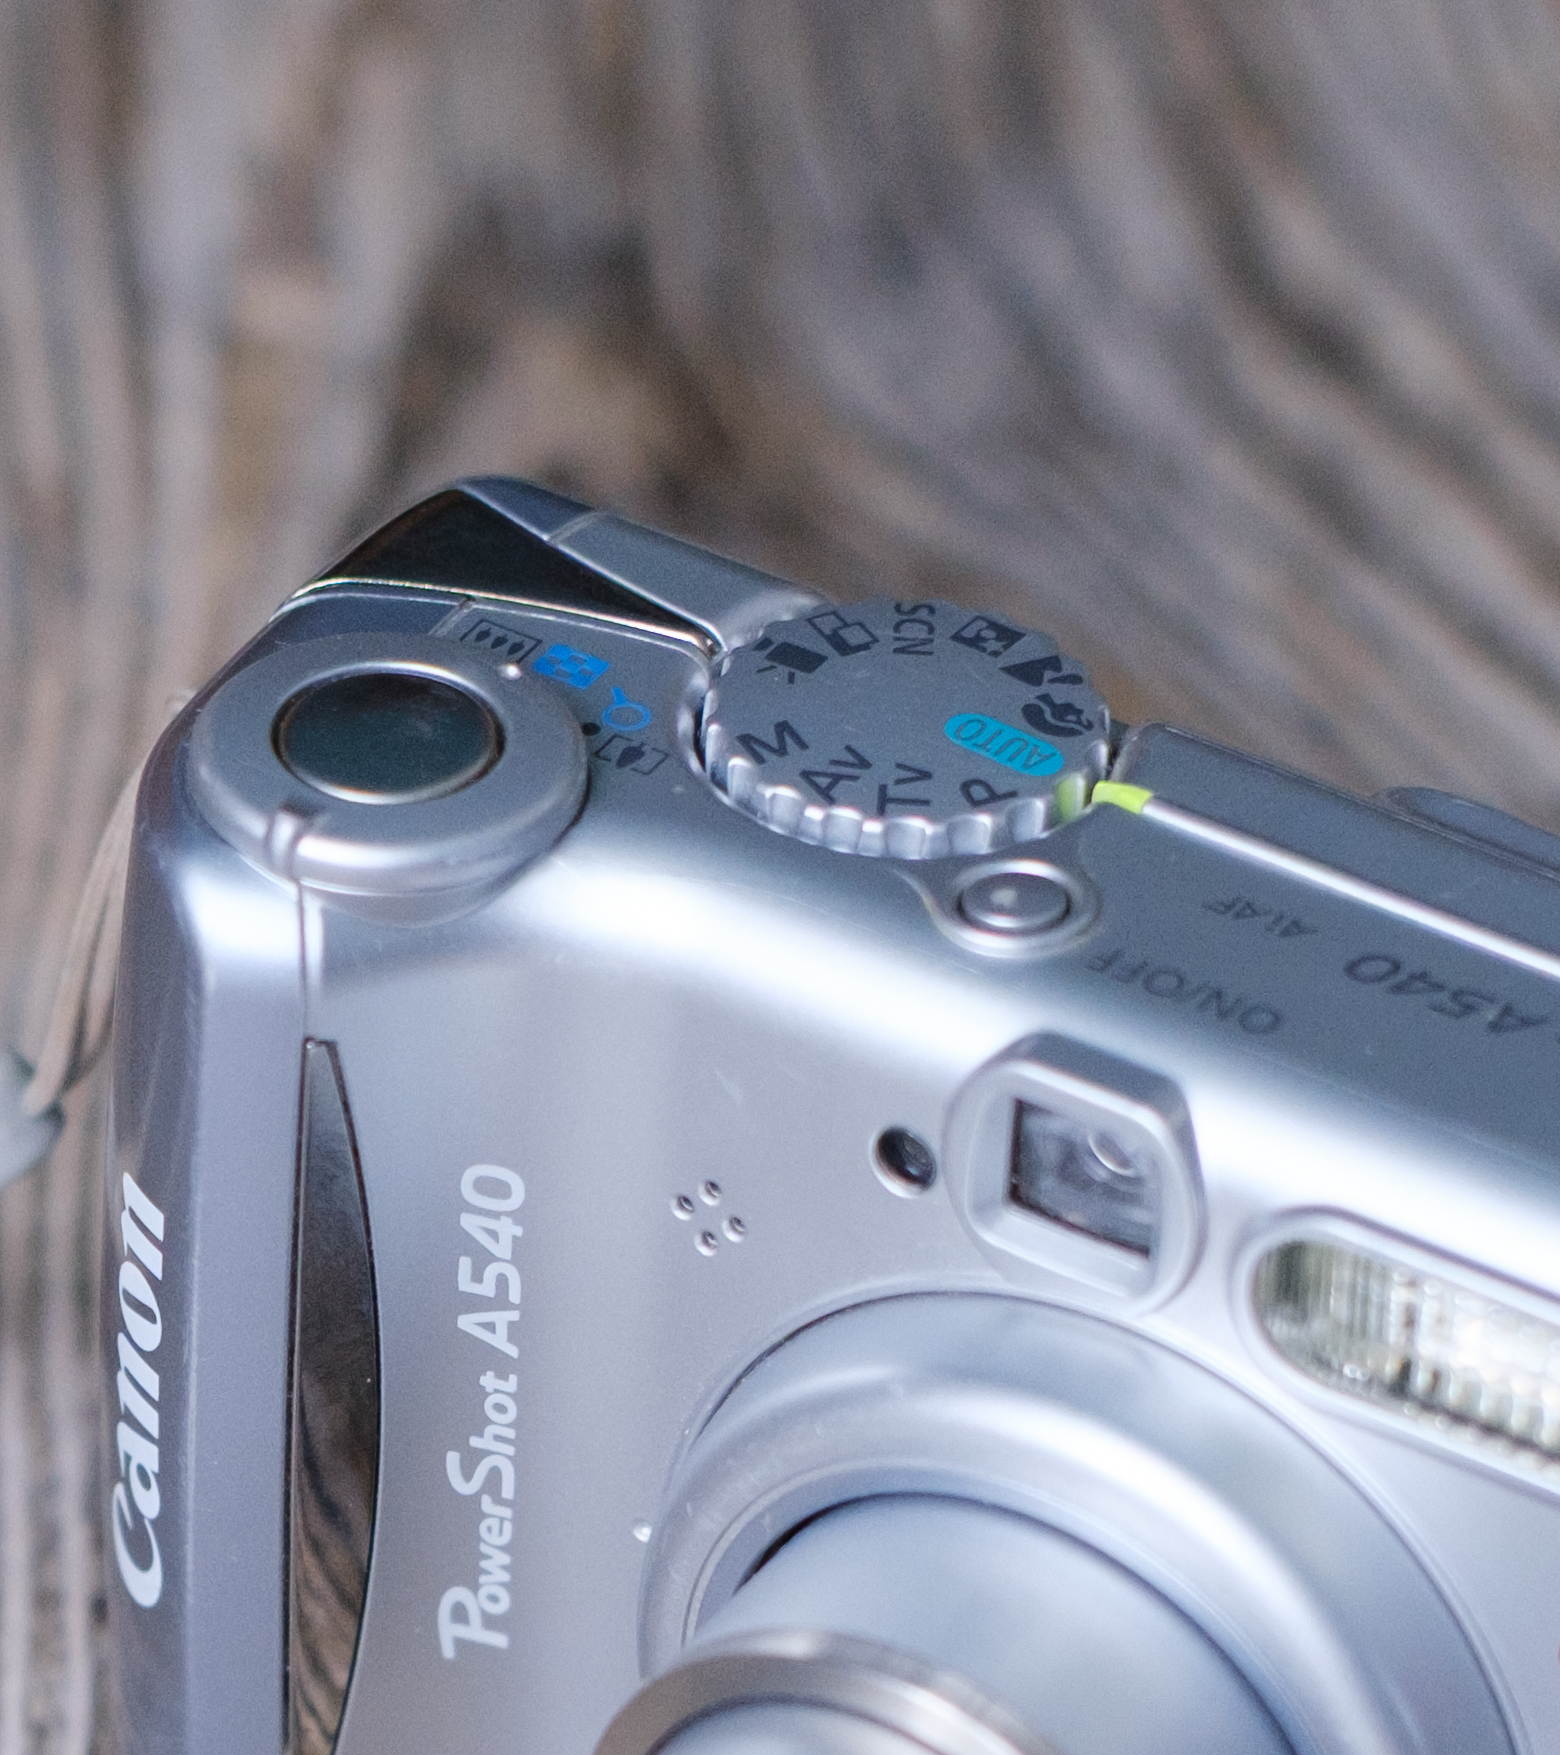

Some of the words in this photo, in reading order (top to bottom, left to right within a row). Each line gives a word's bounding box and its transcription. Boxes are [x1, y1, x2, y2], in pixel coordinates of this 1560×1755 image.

[892, 602, 936, 657] SCN
[736, 719, 809, 765] M
[954, 718, 1058, 771] AUTO
[959, 778, 1019, 808] P
[1342, 953, 1551, 1035] A540
[457, 1162, 527, 1358] A540
[111, 1171, 167, 1608] Canon
[436, 1371, 519, 1660] PowerShot
